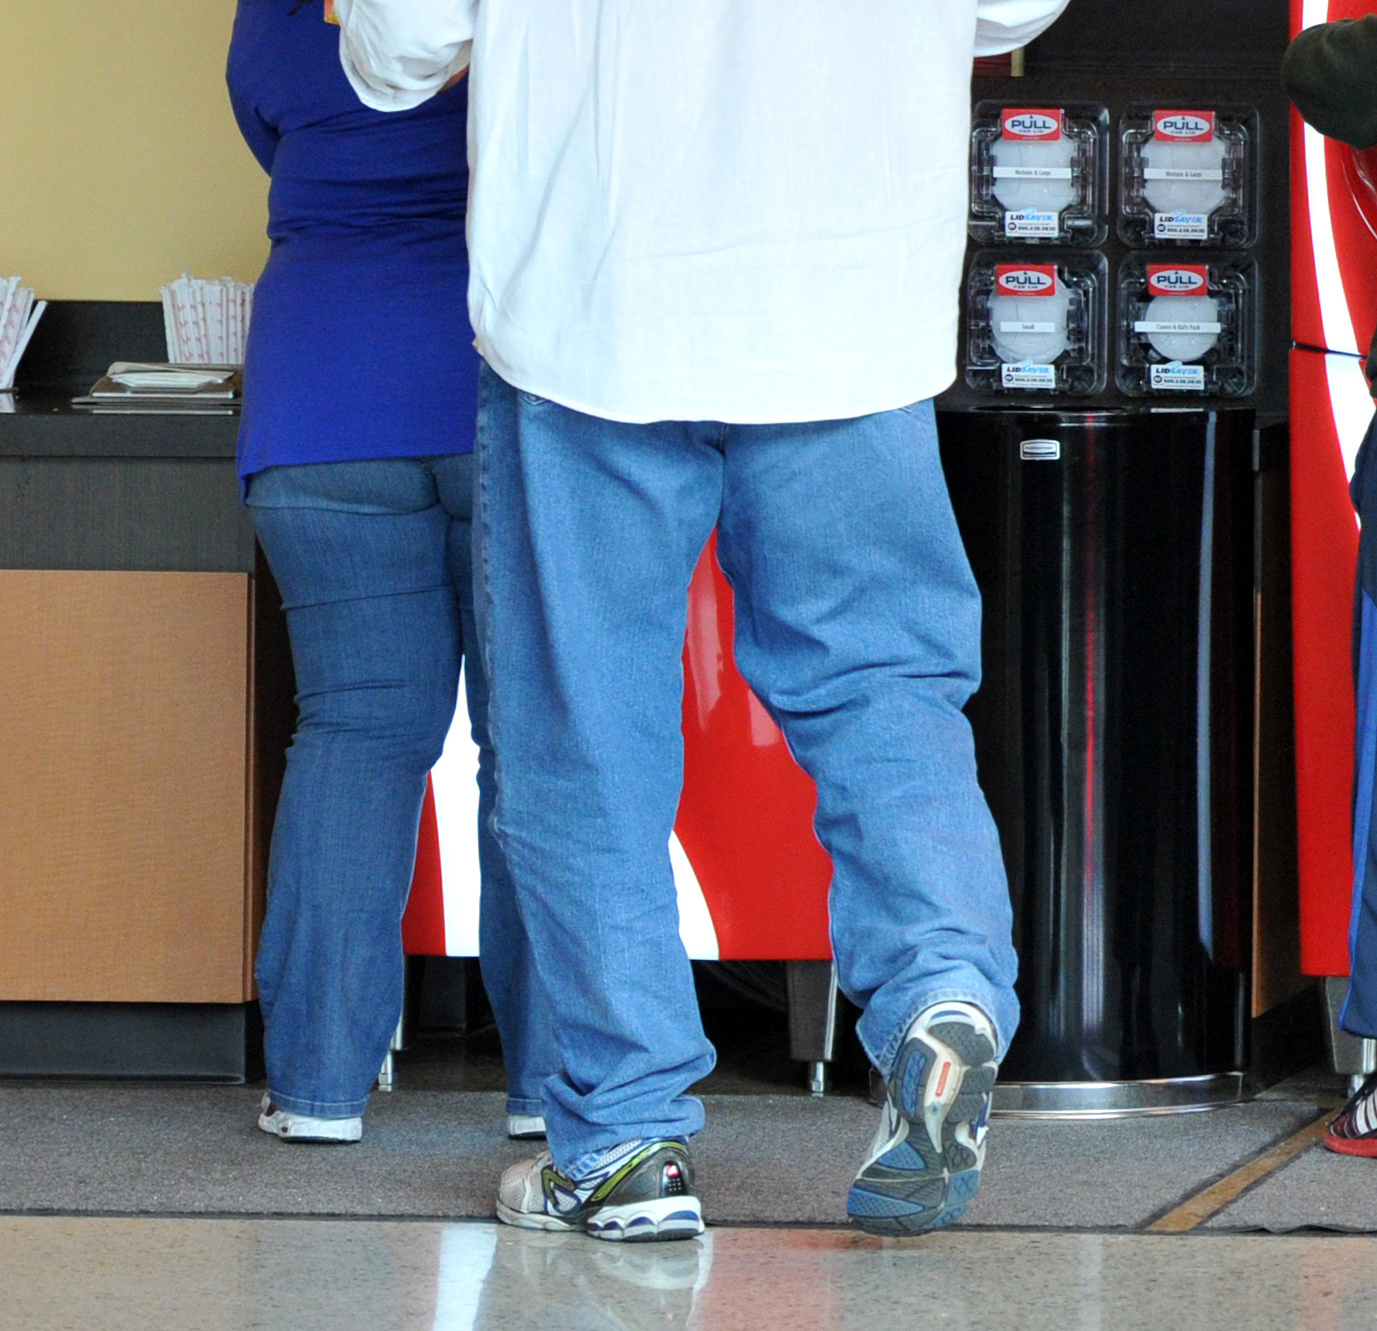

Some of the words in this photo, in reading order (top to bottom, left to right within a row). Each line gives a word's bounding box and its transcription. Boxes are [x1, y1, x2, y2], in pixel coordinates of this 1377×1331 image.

[1011, 120, 1052, 129] PULL
[1163, 121, 1204, 130] PULL
[1006, 276, 1046, 285] PULL
[1156, 275, 1197, 284] PULL
